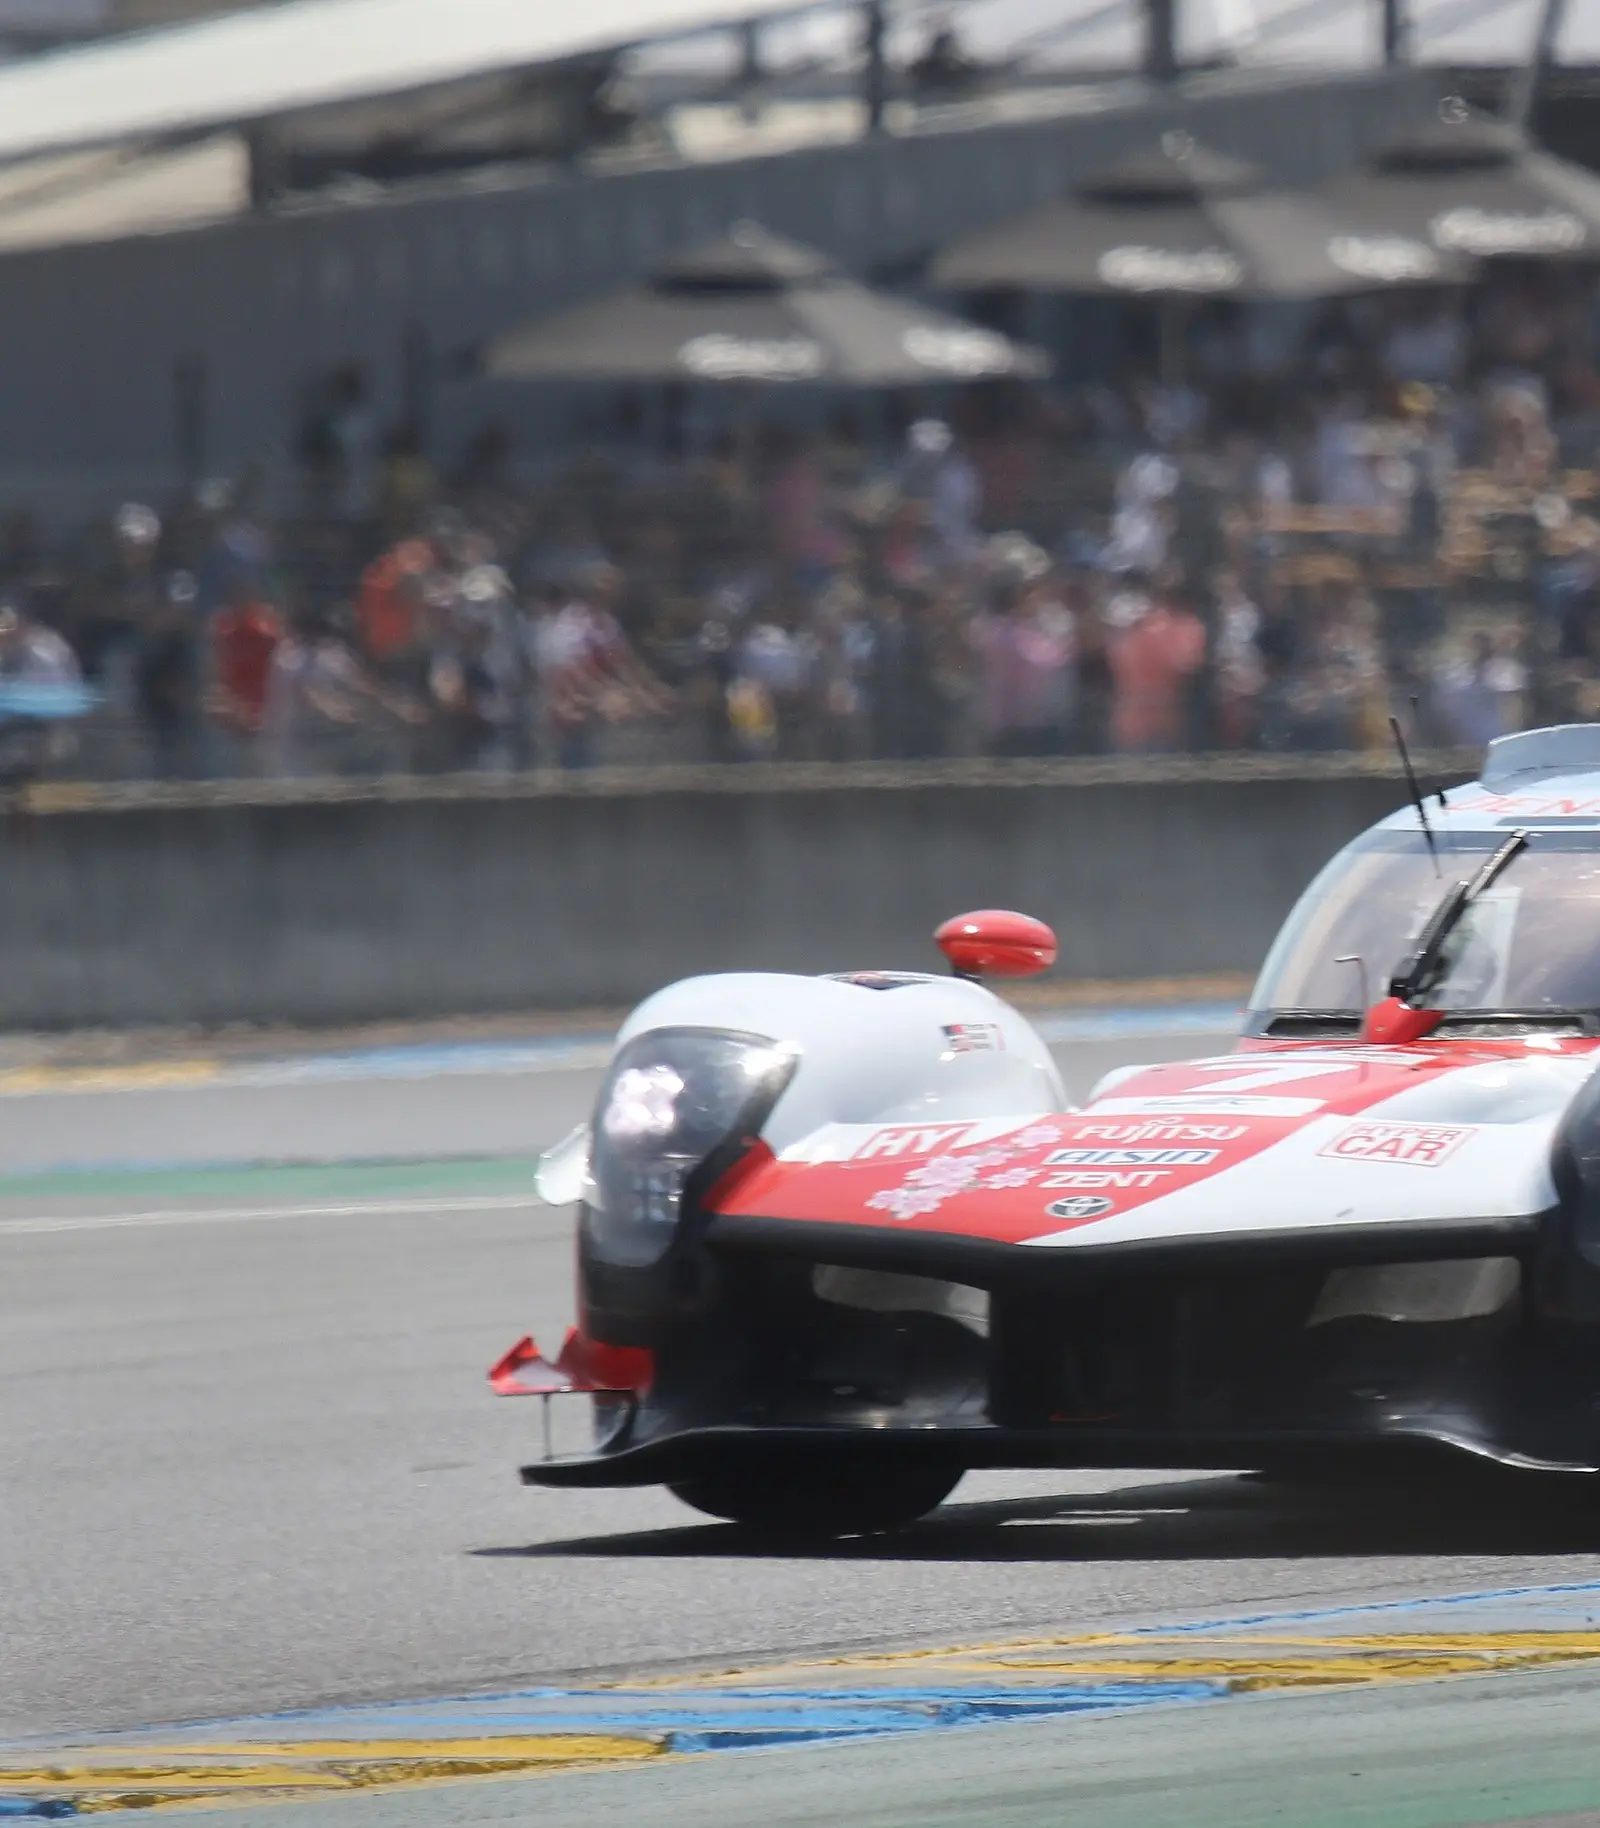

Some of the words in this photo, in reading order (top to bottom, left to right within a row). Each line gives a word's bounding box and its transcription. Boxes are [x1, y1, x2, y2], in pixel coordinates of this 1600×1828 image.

[1181, 1062, 1360, 1093] 7
[855, 1126, 966, 1159] HY
[1071, 1123, 1251, 1144] FUJITSU
[1356, 1124, 1458, 1141] HYPER
[1049, 1150, 1211, 1164] AISIN
[1335, 1135, 1446, 1162] CAR
[1038, 1170, 1173, 1188] ZENT
